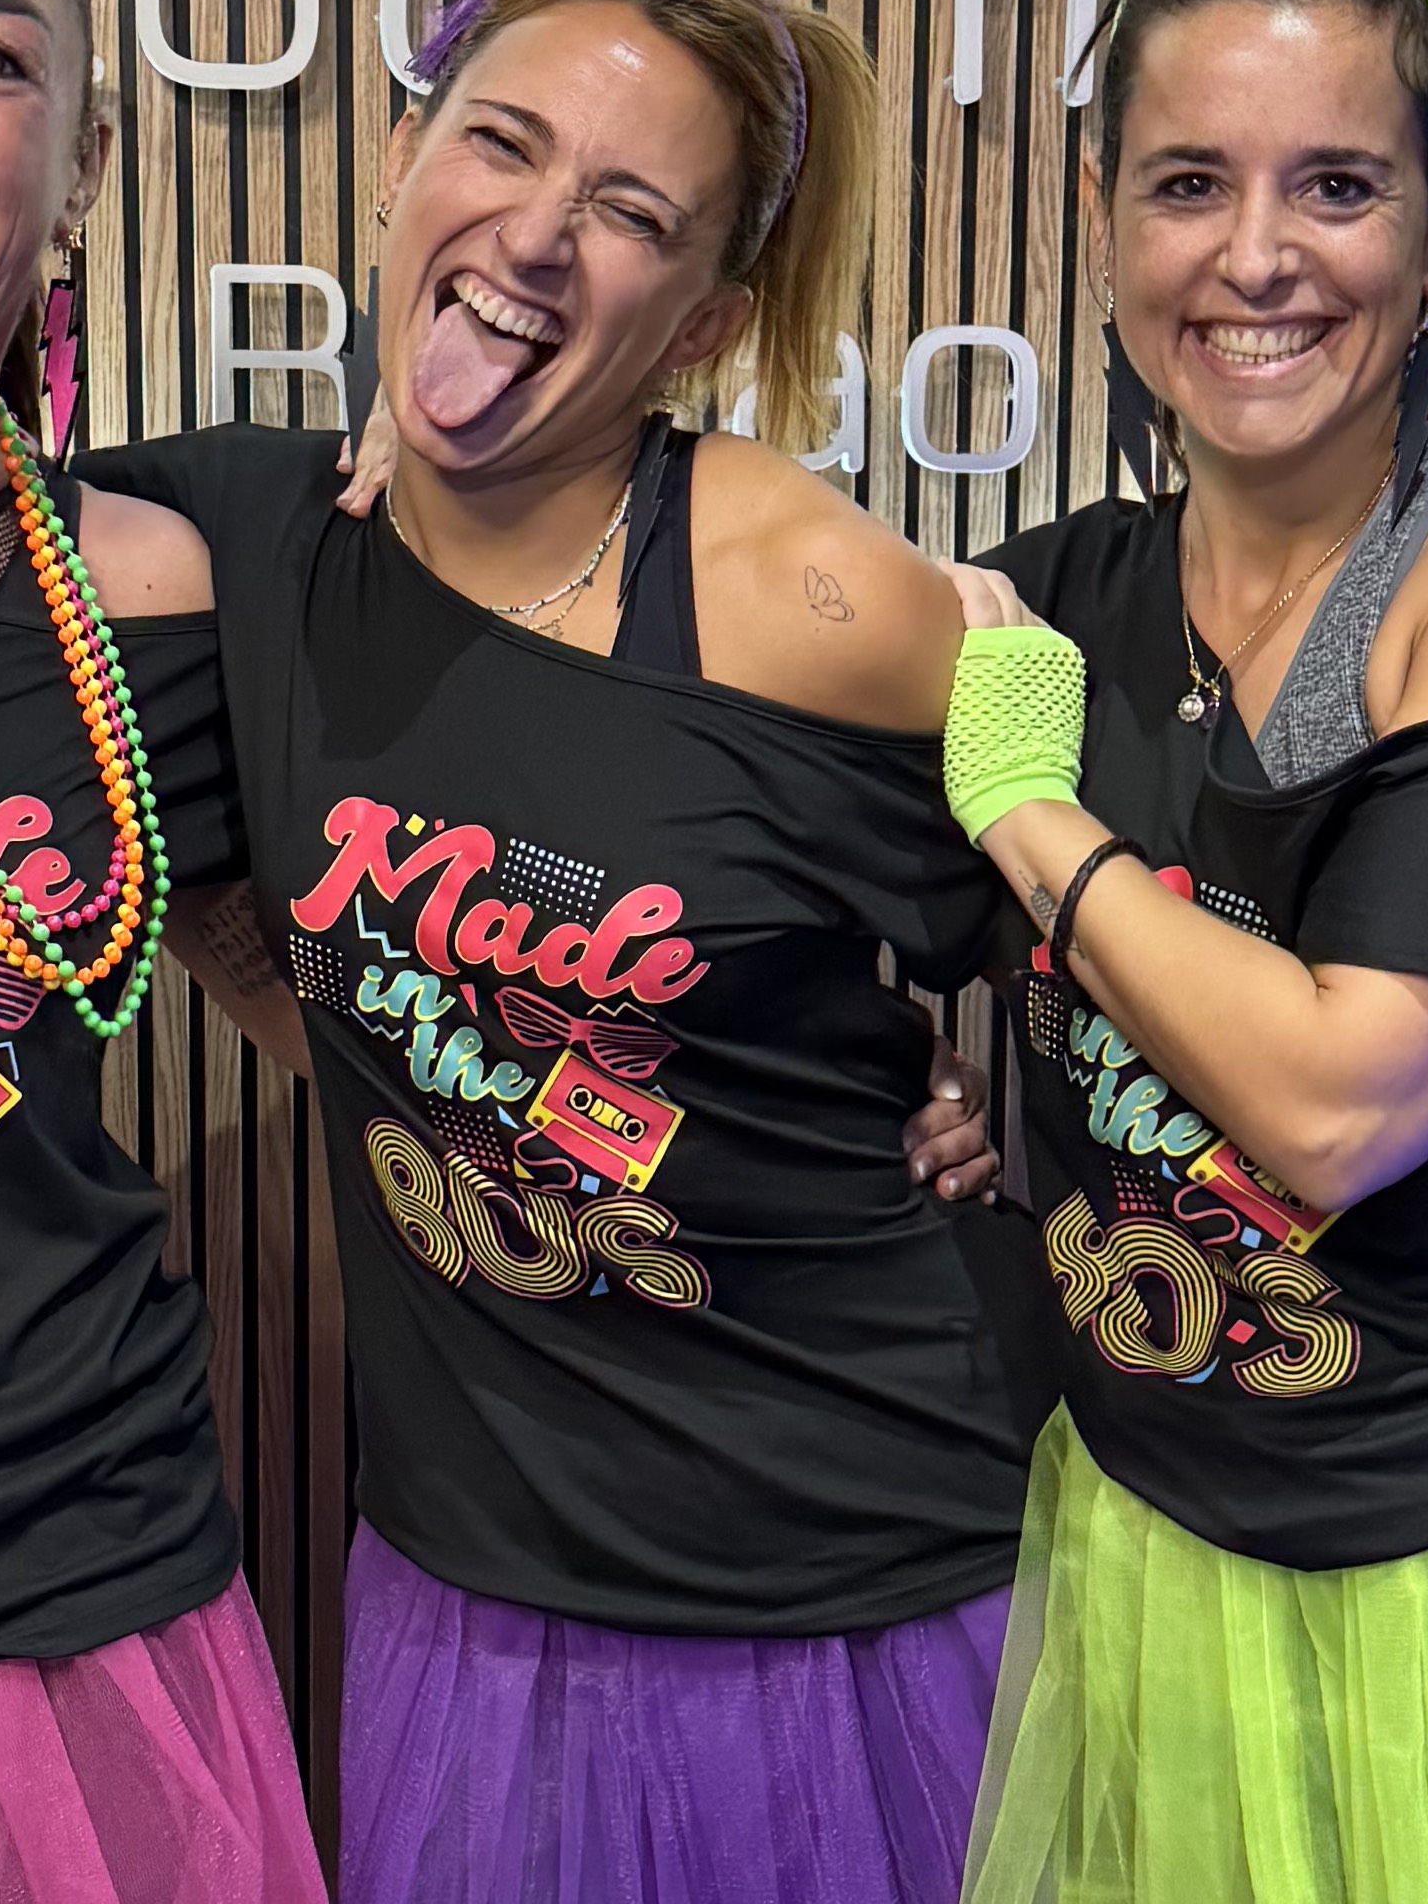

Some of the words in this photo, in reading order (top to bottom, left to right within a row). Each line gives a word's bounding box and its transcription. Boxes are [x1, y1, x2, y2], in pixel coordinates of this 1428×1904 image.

[290, 796, 711, 1004] Made
[356, 965, 457, 1022] in
[405, 1023, 536, 1102] the
[1069, 1007, 1142, 1069] in
[1088, 1068, 1214, 1157] the
